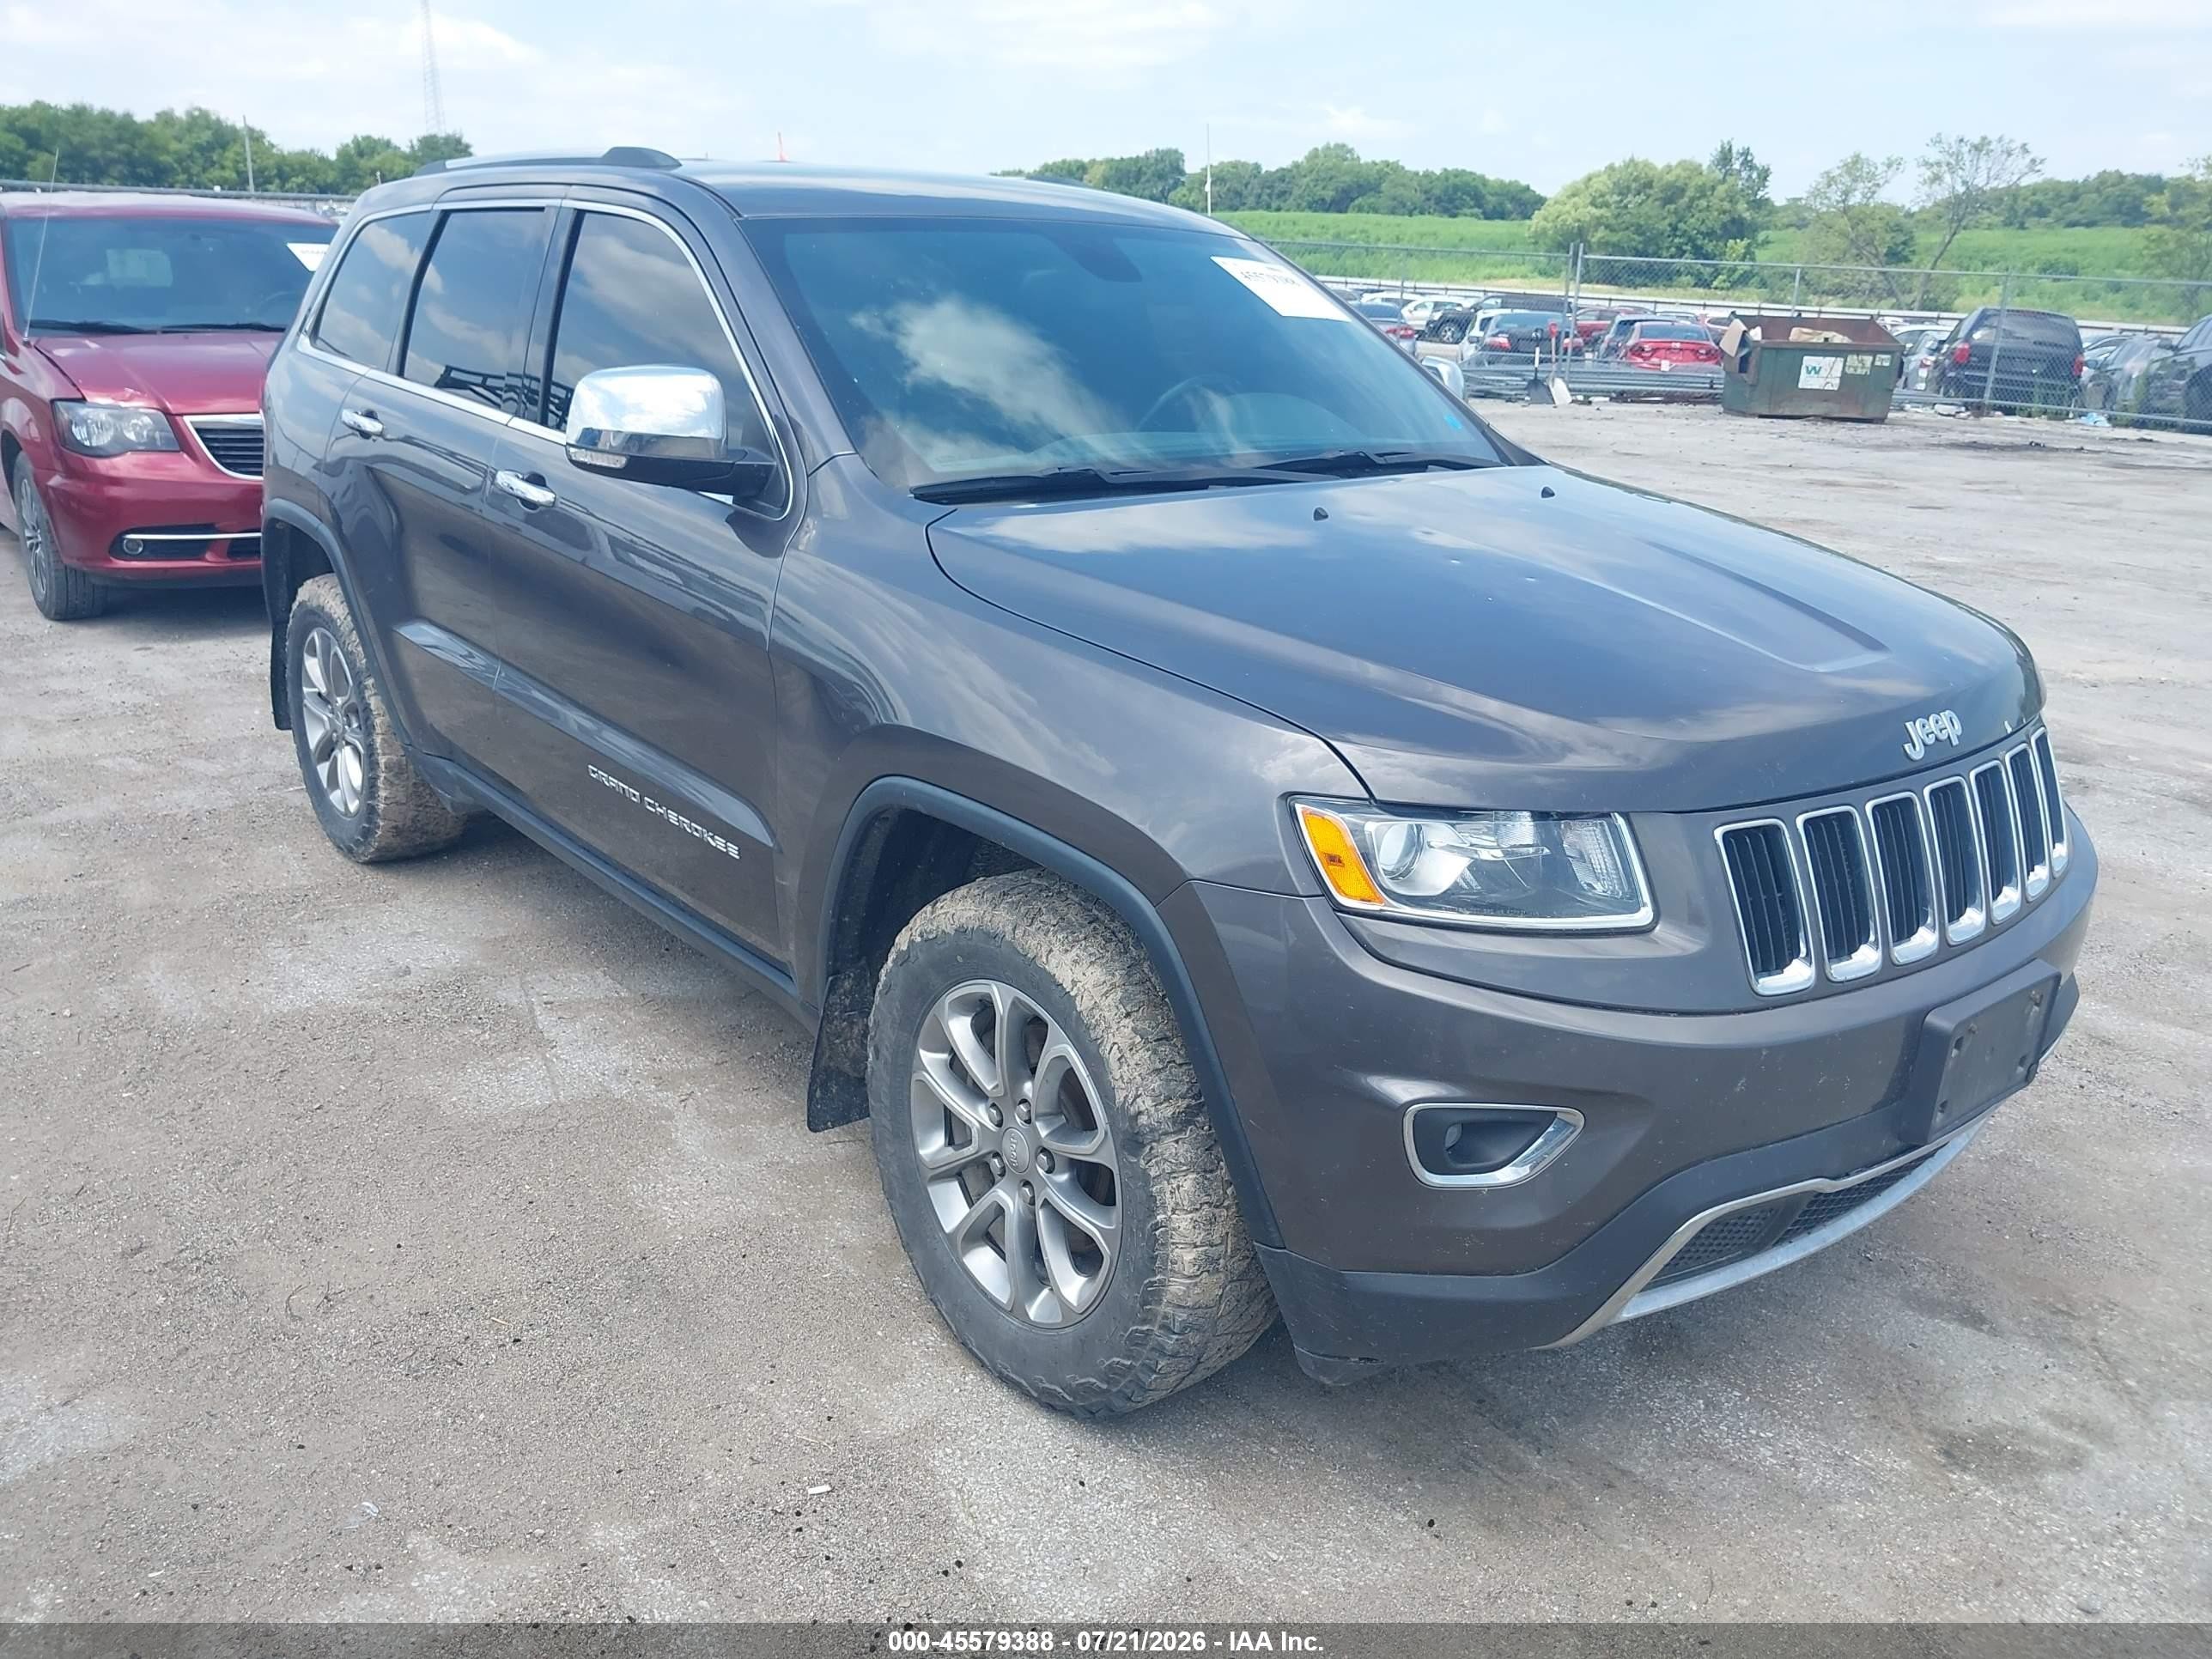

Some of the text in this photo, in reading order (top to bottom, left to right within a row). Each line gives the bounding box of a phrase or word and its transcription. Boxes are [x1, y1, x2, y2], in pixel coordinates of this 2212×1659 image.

[1902, 709, 1963, 761] Jeep
[587, 763, 742, 860] GRAND CHEROKEE
